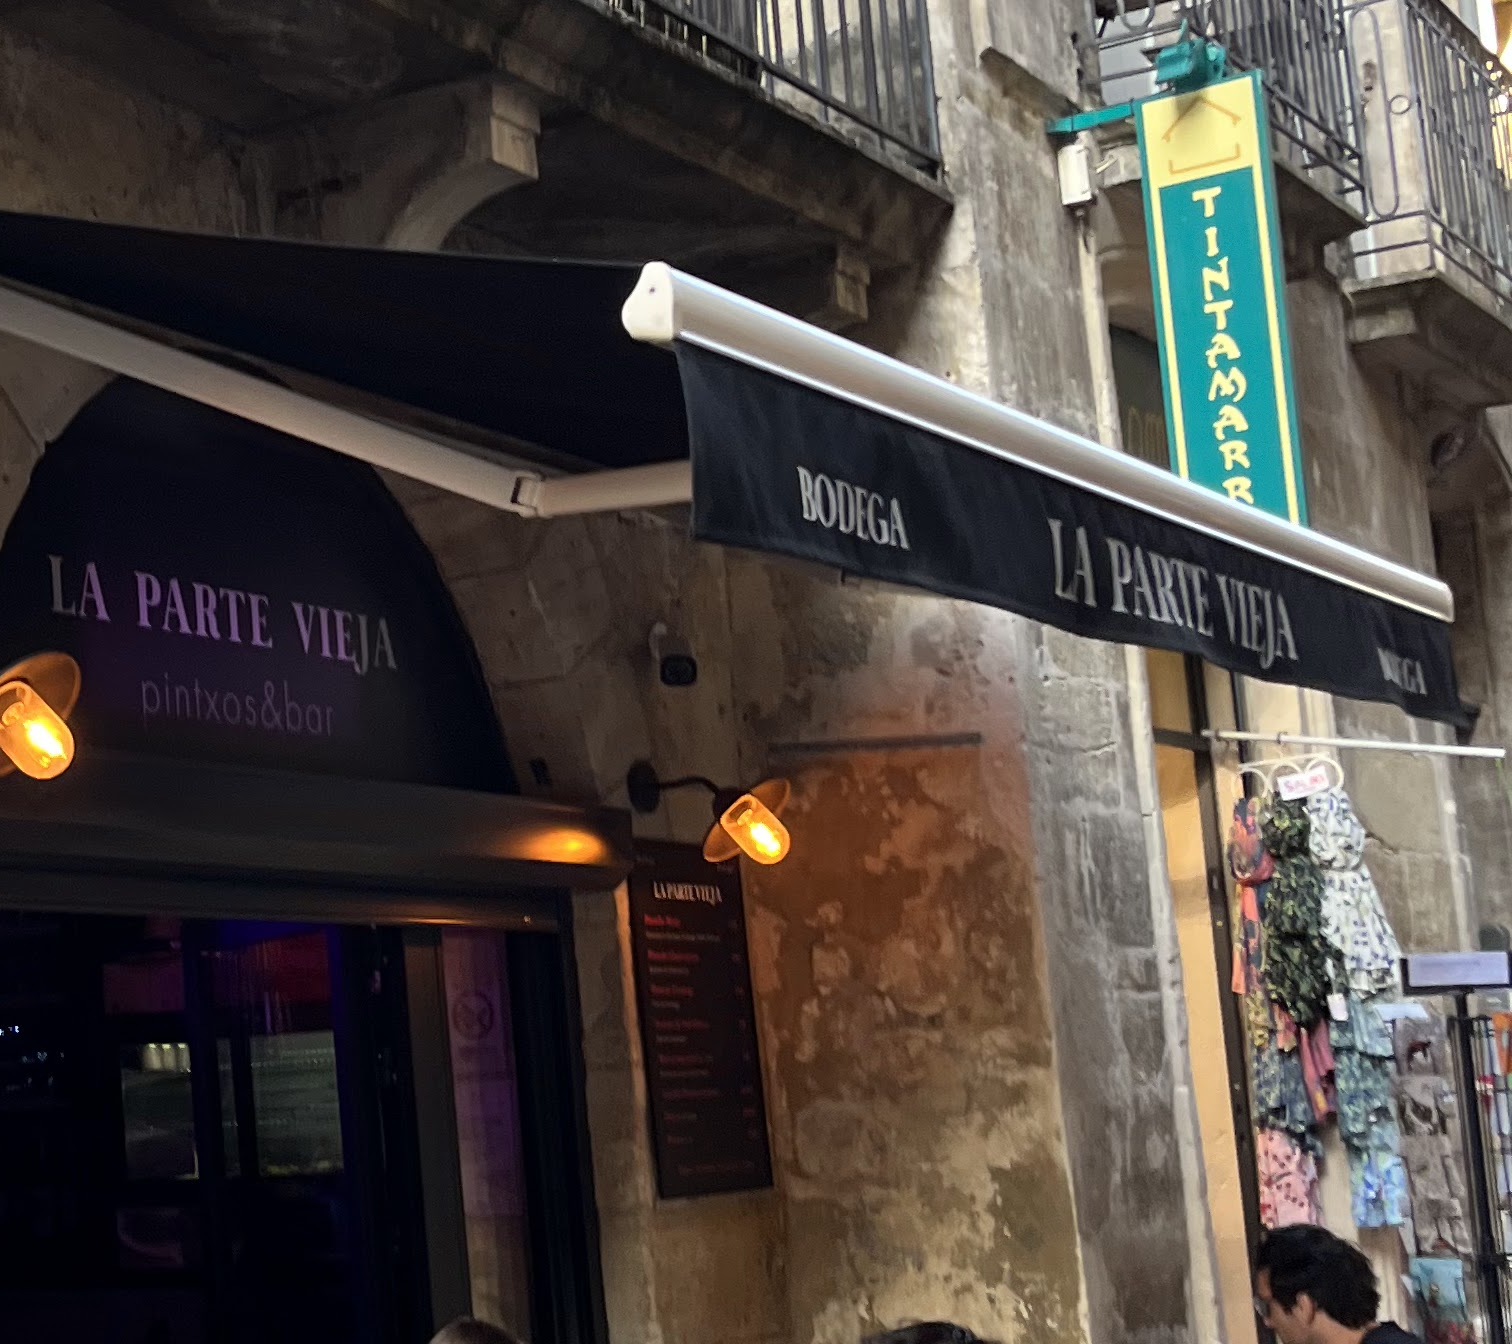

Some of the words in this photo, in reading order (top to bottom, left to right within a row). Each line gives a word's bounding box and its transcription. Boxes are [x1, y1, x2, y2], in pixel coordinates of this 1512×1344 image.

[796, 464, 910, 551] BODEGA
[48, 554, 112, 623] LA
[134, 569, 274, 649] PARTE
[291, 600, 398, 677] VIEJA
[1047, 517, 1098, 608] LA
[1104, 536, 1215, 638] PARTE
[1215, 572, 1299, 670] VIEJA
